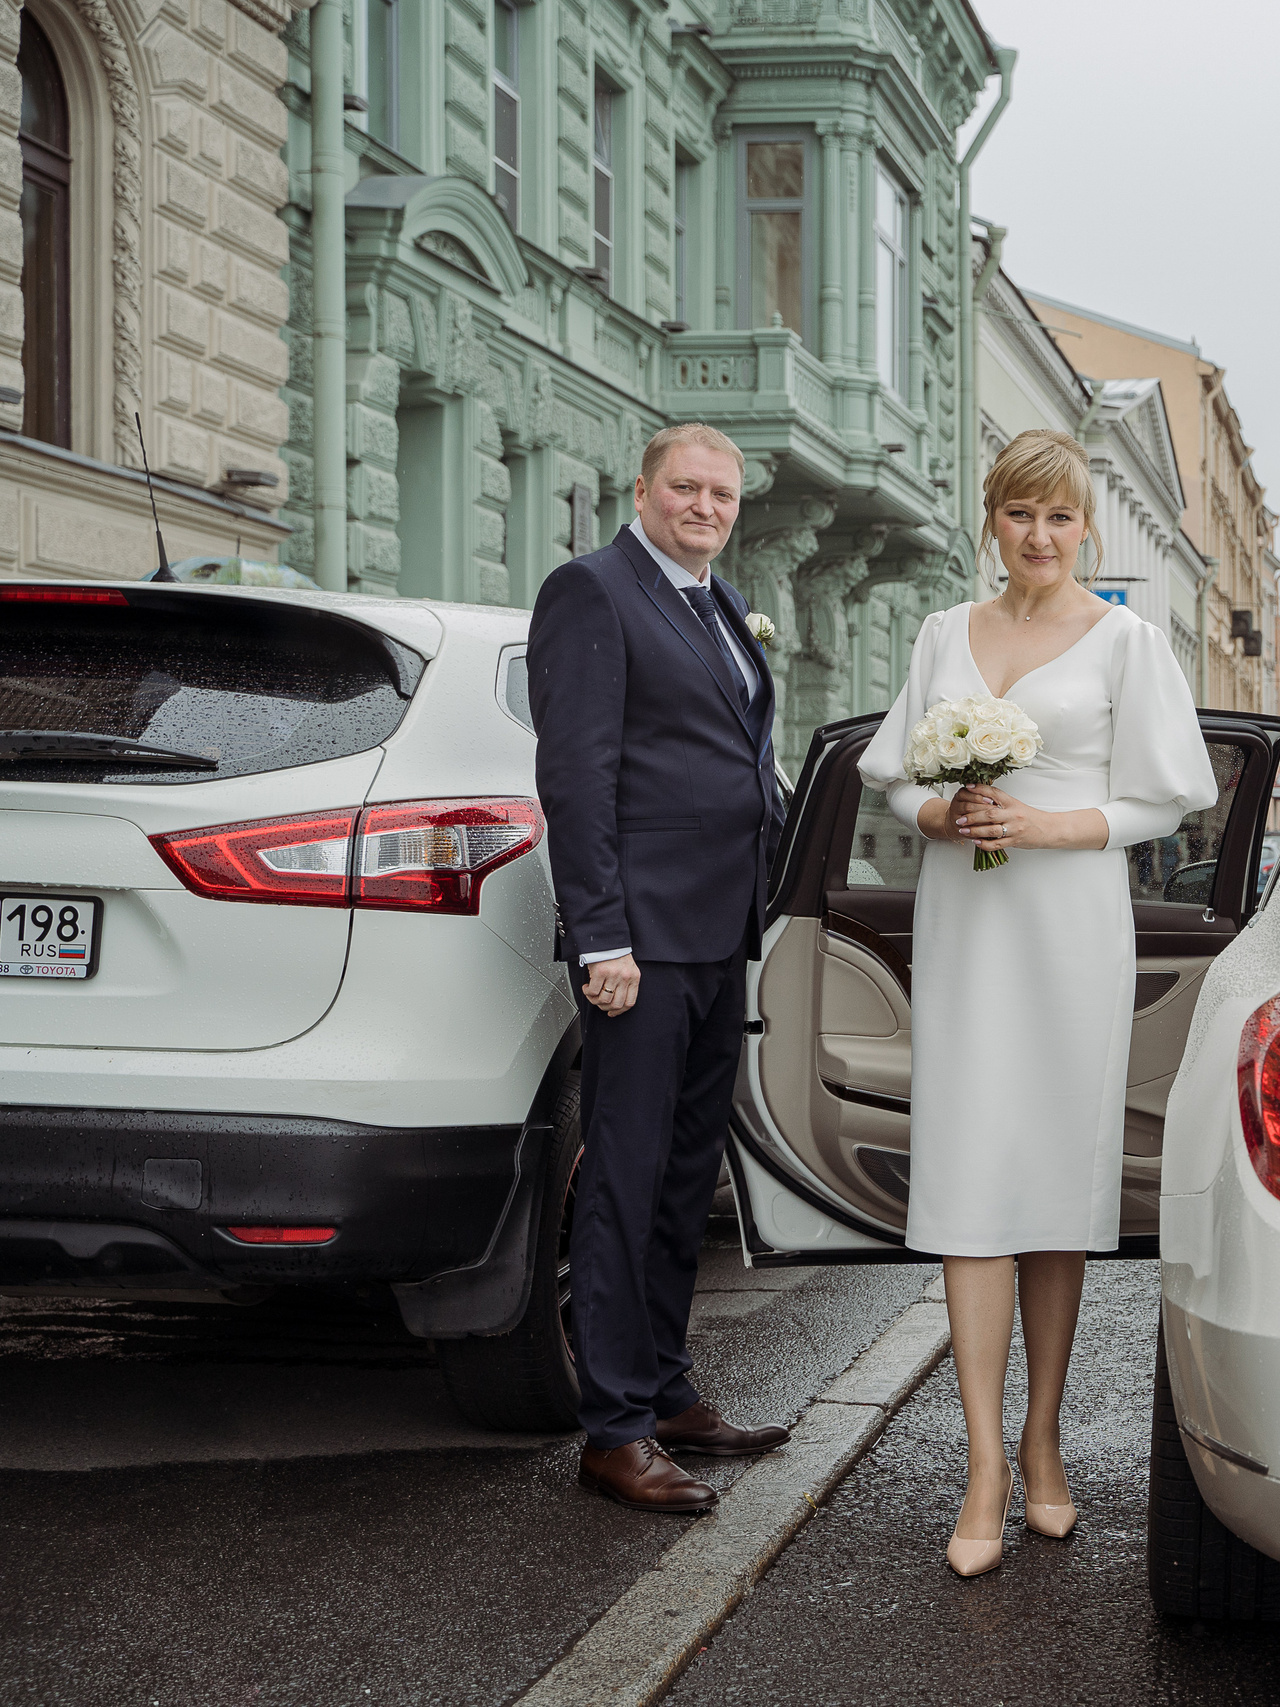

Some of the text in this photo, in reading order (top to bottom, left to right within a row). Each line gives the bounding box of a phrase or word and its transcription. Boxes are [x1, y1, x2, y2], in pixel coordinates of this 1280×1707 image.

[6, 904, 79, 942] 198
[20, 943, 57, 957] RUS
[36, 966, 76, 976] TOYOTA
